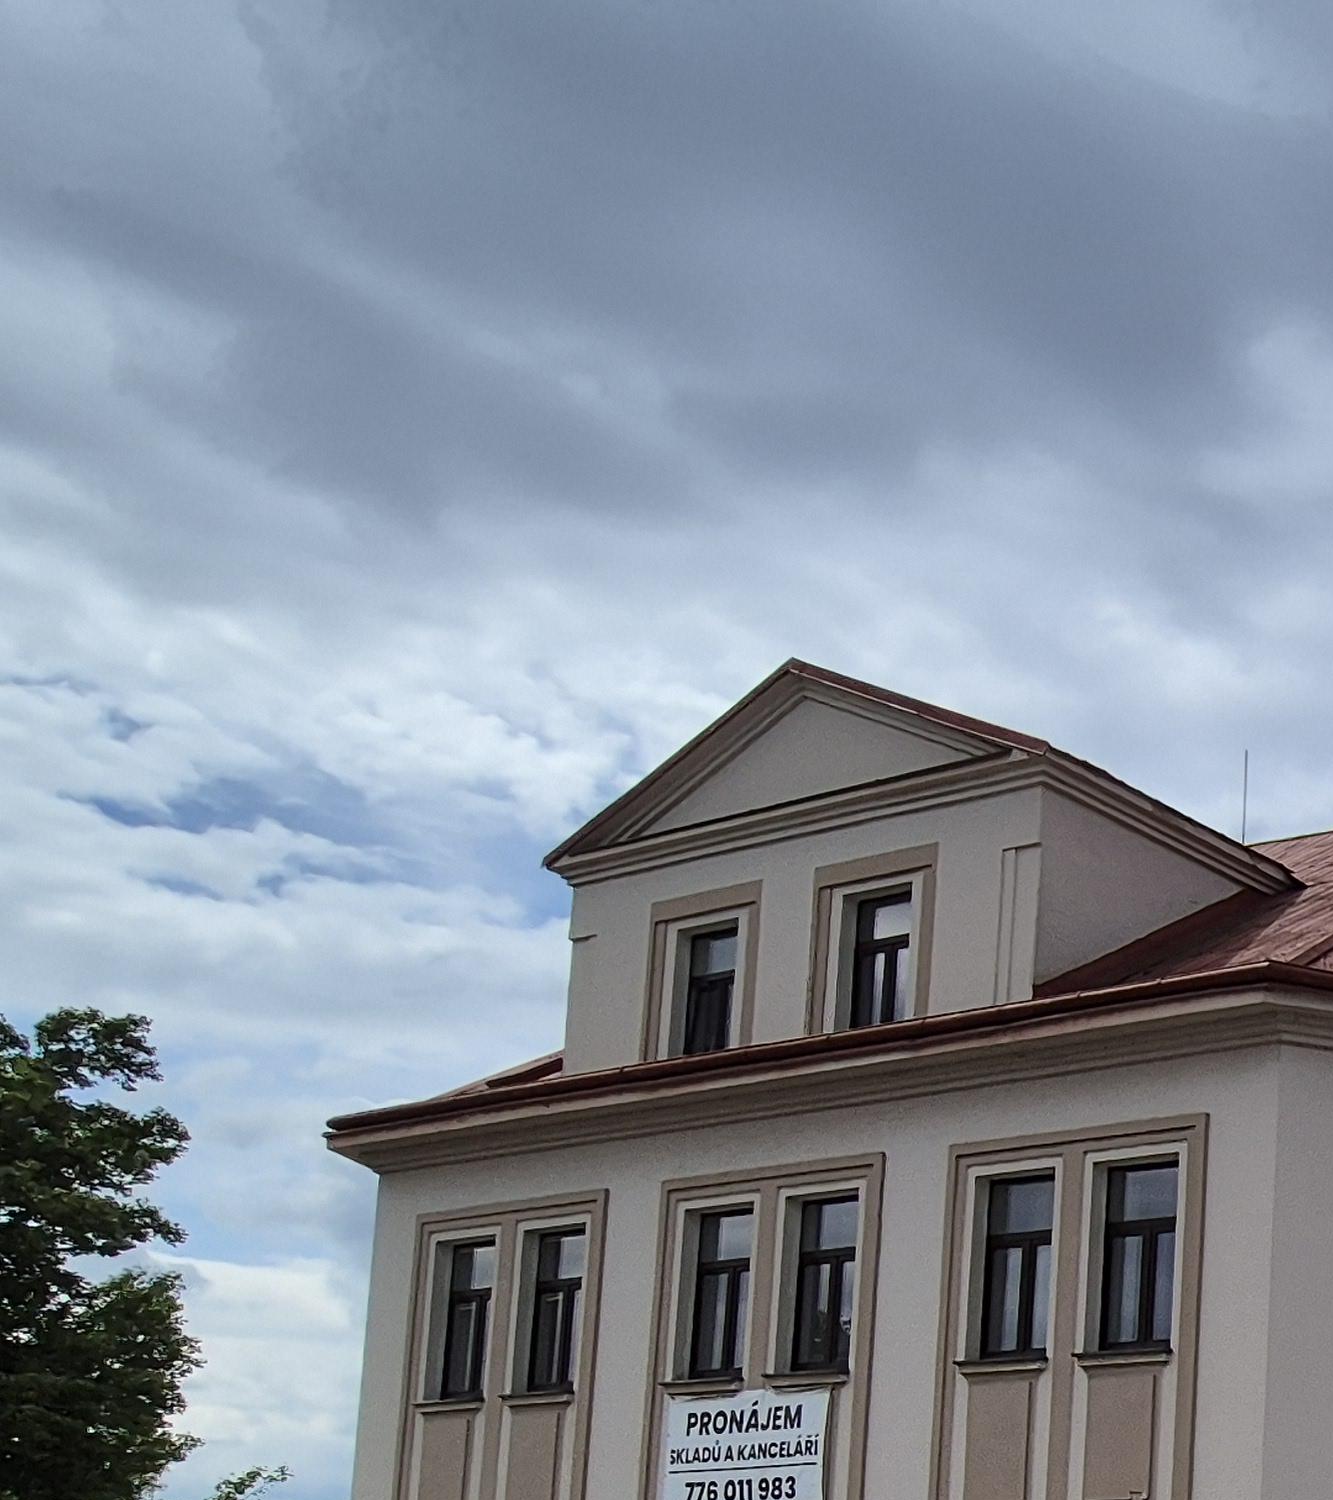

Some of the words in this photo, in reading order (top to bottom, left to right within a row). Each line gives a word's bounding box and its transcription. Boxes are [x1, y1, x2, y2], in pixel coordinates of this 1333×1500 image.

[686, 1400, 803, 1437] PRONÁJEM
[669, 1440, 722, 1466] SKLADŮ
[723, 1444, 735, 1463] A
[737, 1433, 820, 1461] KANCELÁŘÍ
[758, 1475, 798, 1500] 983
